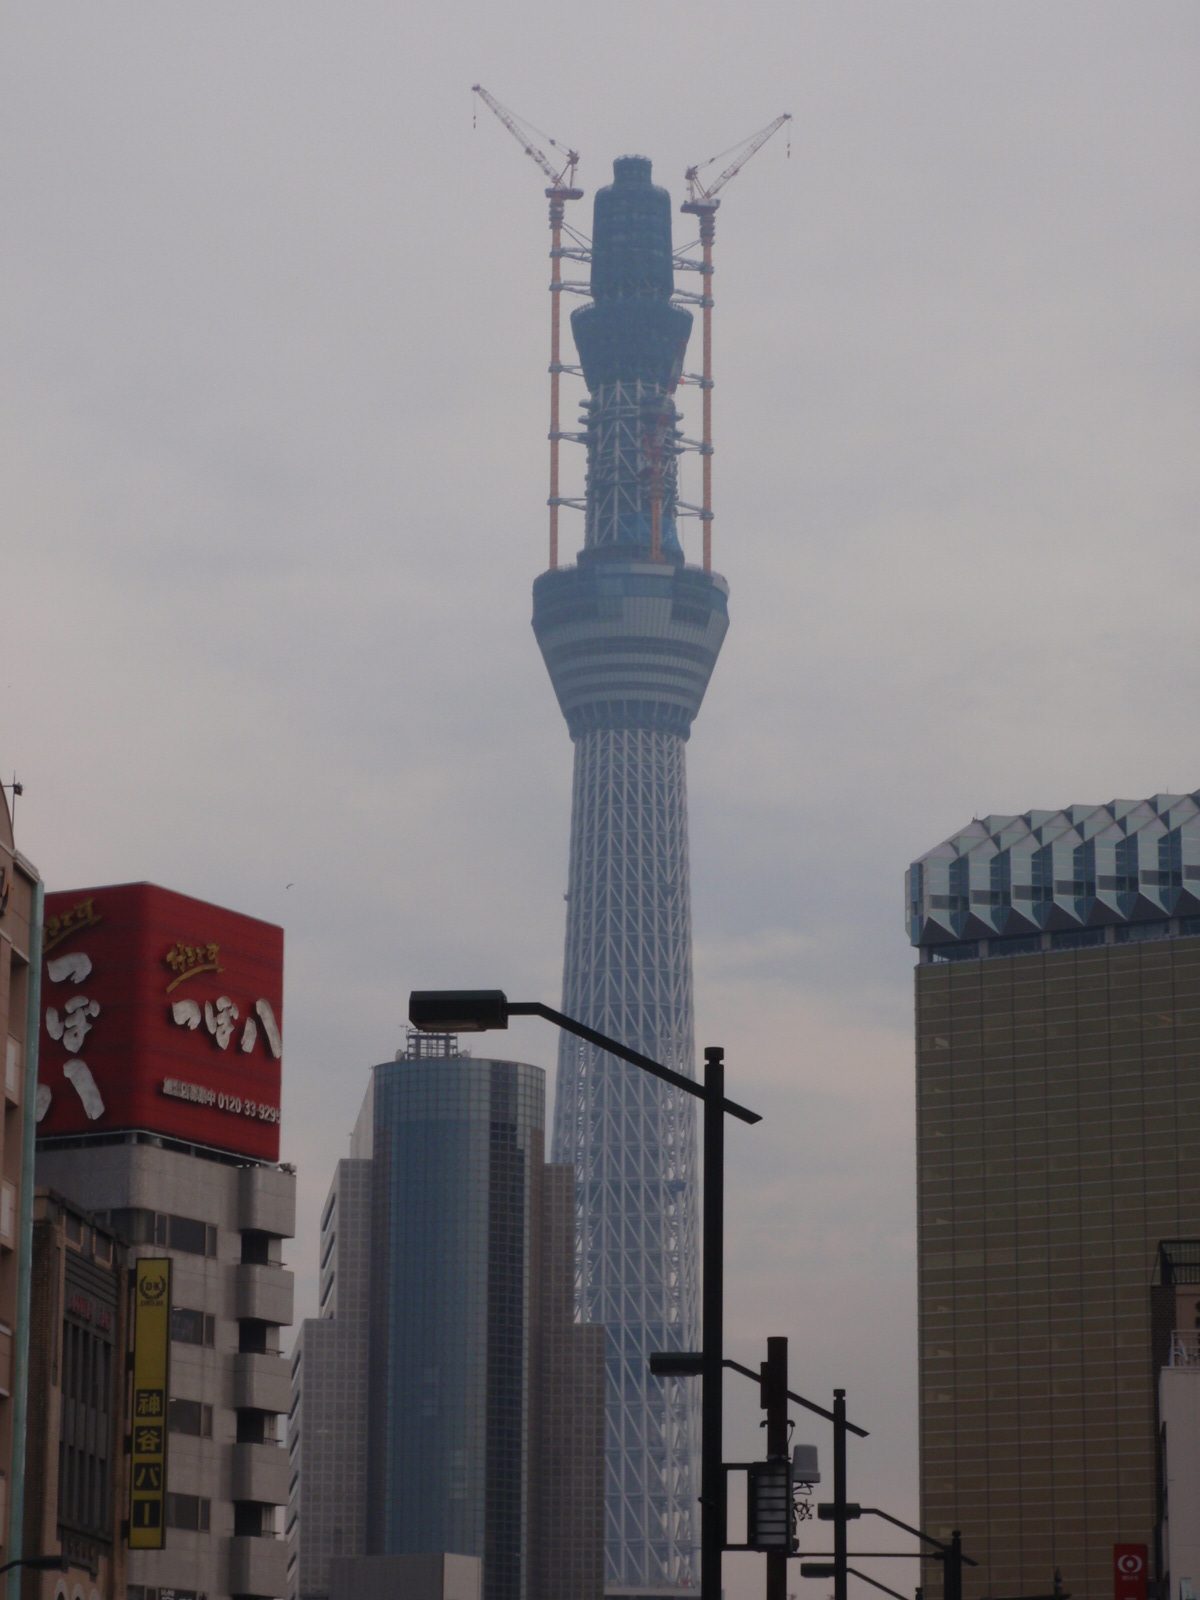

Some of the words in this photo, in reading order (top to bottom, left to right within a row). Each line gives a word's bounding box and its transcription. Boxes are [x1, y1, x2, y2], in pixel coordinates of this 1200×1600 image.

[34, 953, 105, 1121] つぼ八
[172, 996, 281, 1059] つぼ八
[136, 1392, 160, 1526] 神谷バー
